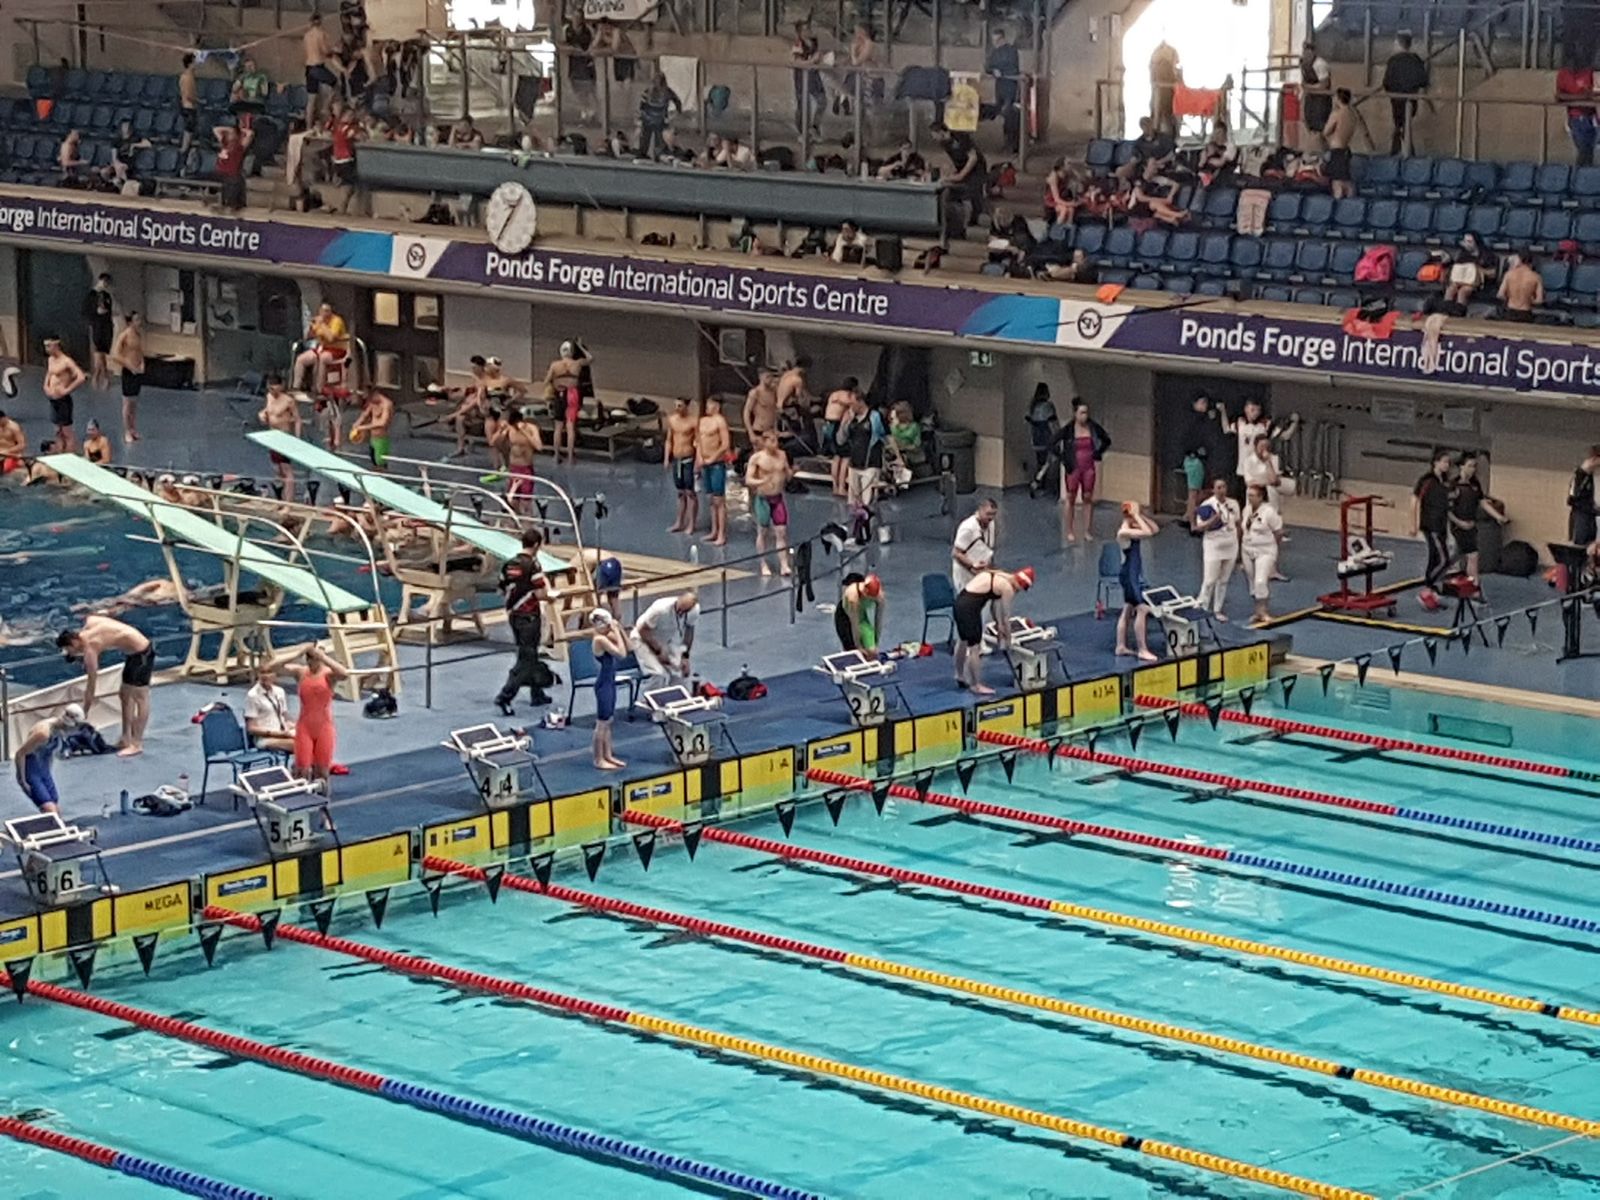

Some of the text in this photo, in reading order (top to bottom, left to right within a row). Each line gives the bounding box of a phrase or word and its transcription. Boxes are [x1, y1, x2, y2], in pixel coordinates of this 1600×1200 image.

[0, 205, 260, 251] orge International Sports Centre
[485, 251, 889, 316] Ponds Forge International Sports Centre
[1180, 318, 1256, 353] Ponds
[1262, 326, 1336, 367] Forge
[1515, 349, 1600, 388] Sports
[1015, 661, 1023, 682] 1
[851, 697, 862, 719] 2
[872, 696, 881, 715] 2
[674, 734, 684, 755] 3
[481, 776, 491, 798] 4
[503, 773, 513, 795] 4
[270, 821, 281, 844] 5
[292, 818, 304, 841] 5
[37, 871, 47, 895] 6
[60, 869, 73, 892] 6
